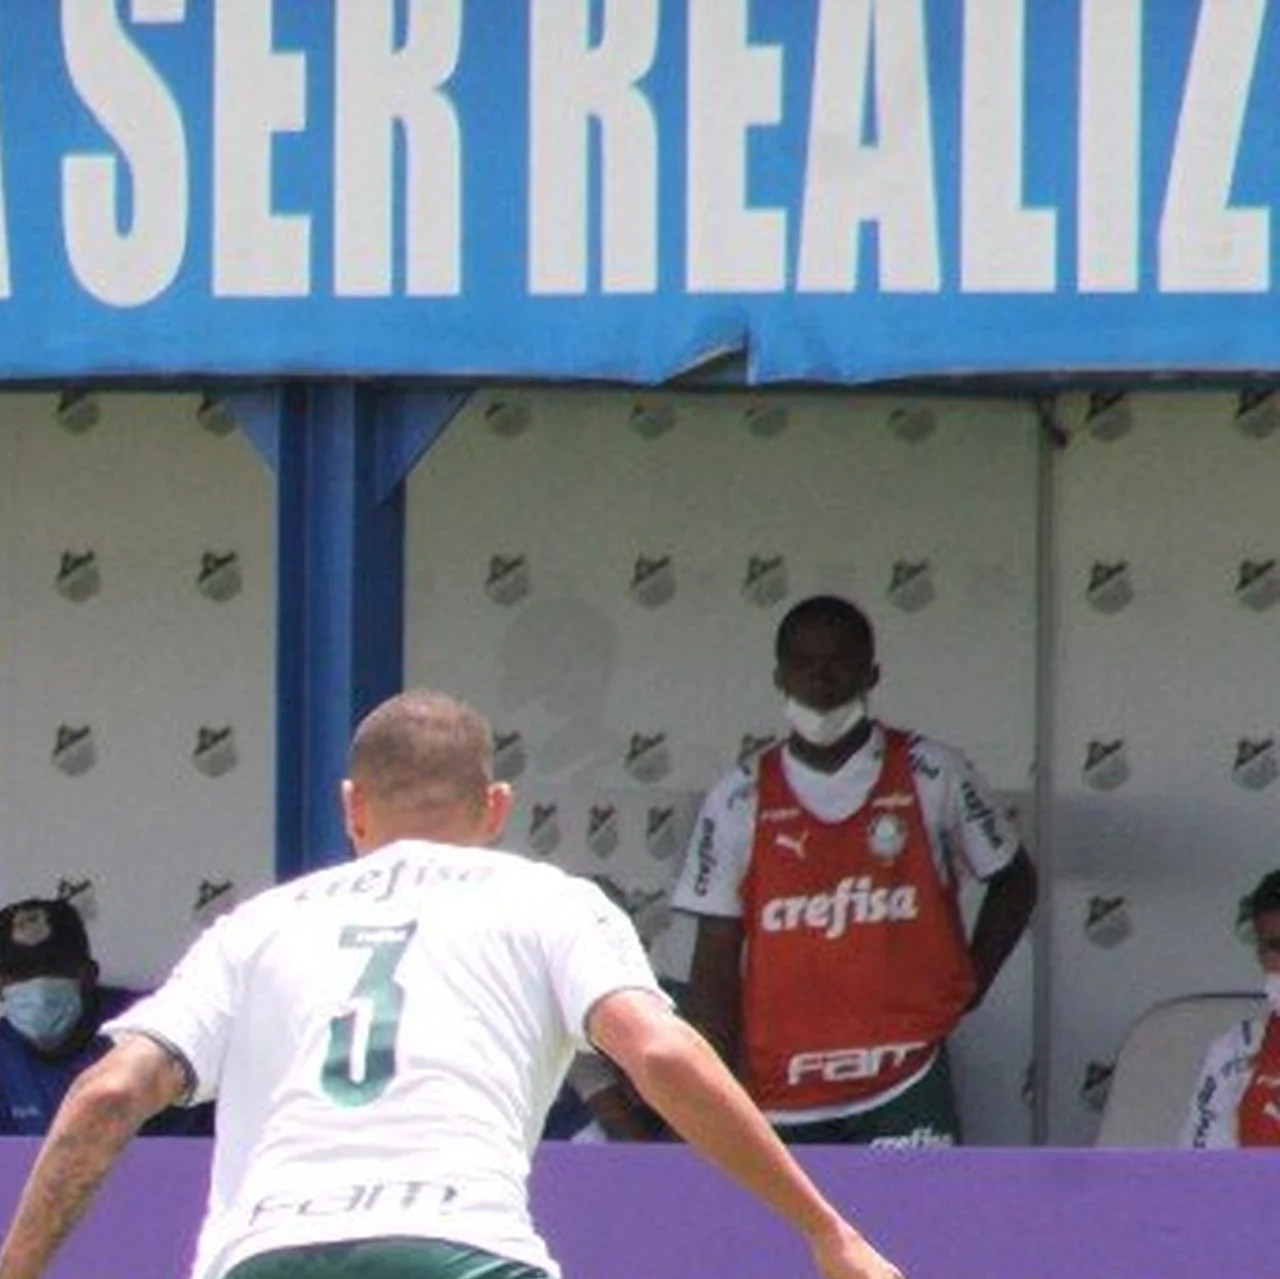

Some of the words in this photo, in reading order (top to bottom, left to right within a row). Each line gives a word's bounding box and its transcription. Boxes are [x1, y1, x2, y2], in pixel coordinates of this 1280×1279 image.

[60, 0, 462, 308] SER
[759, 875, 920, 940] crefisa
[320, 919, 421, 1109] 3
